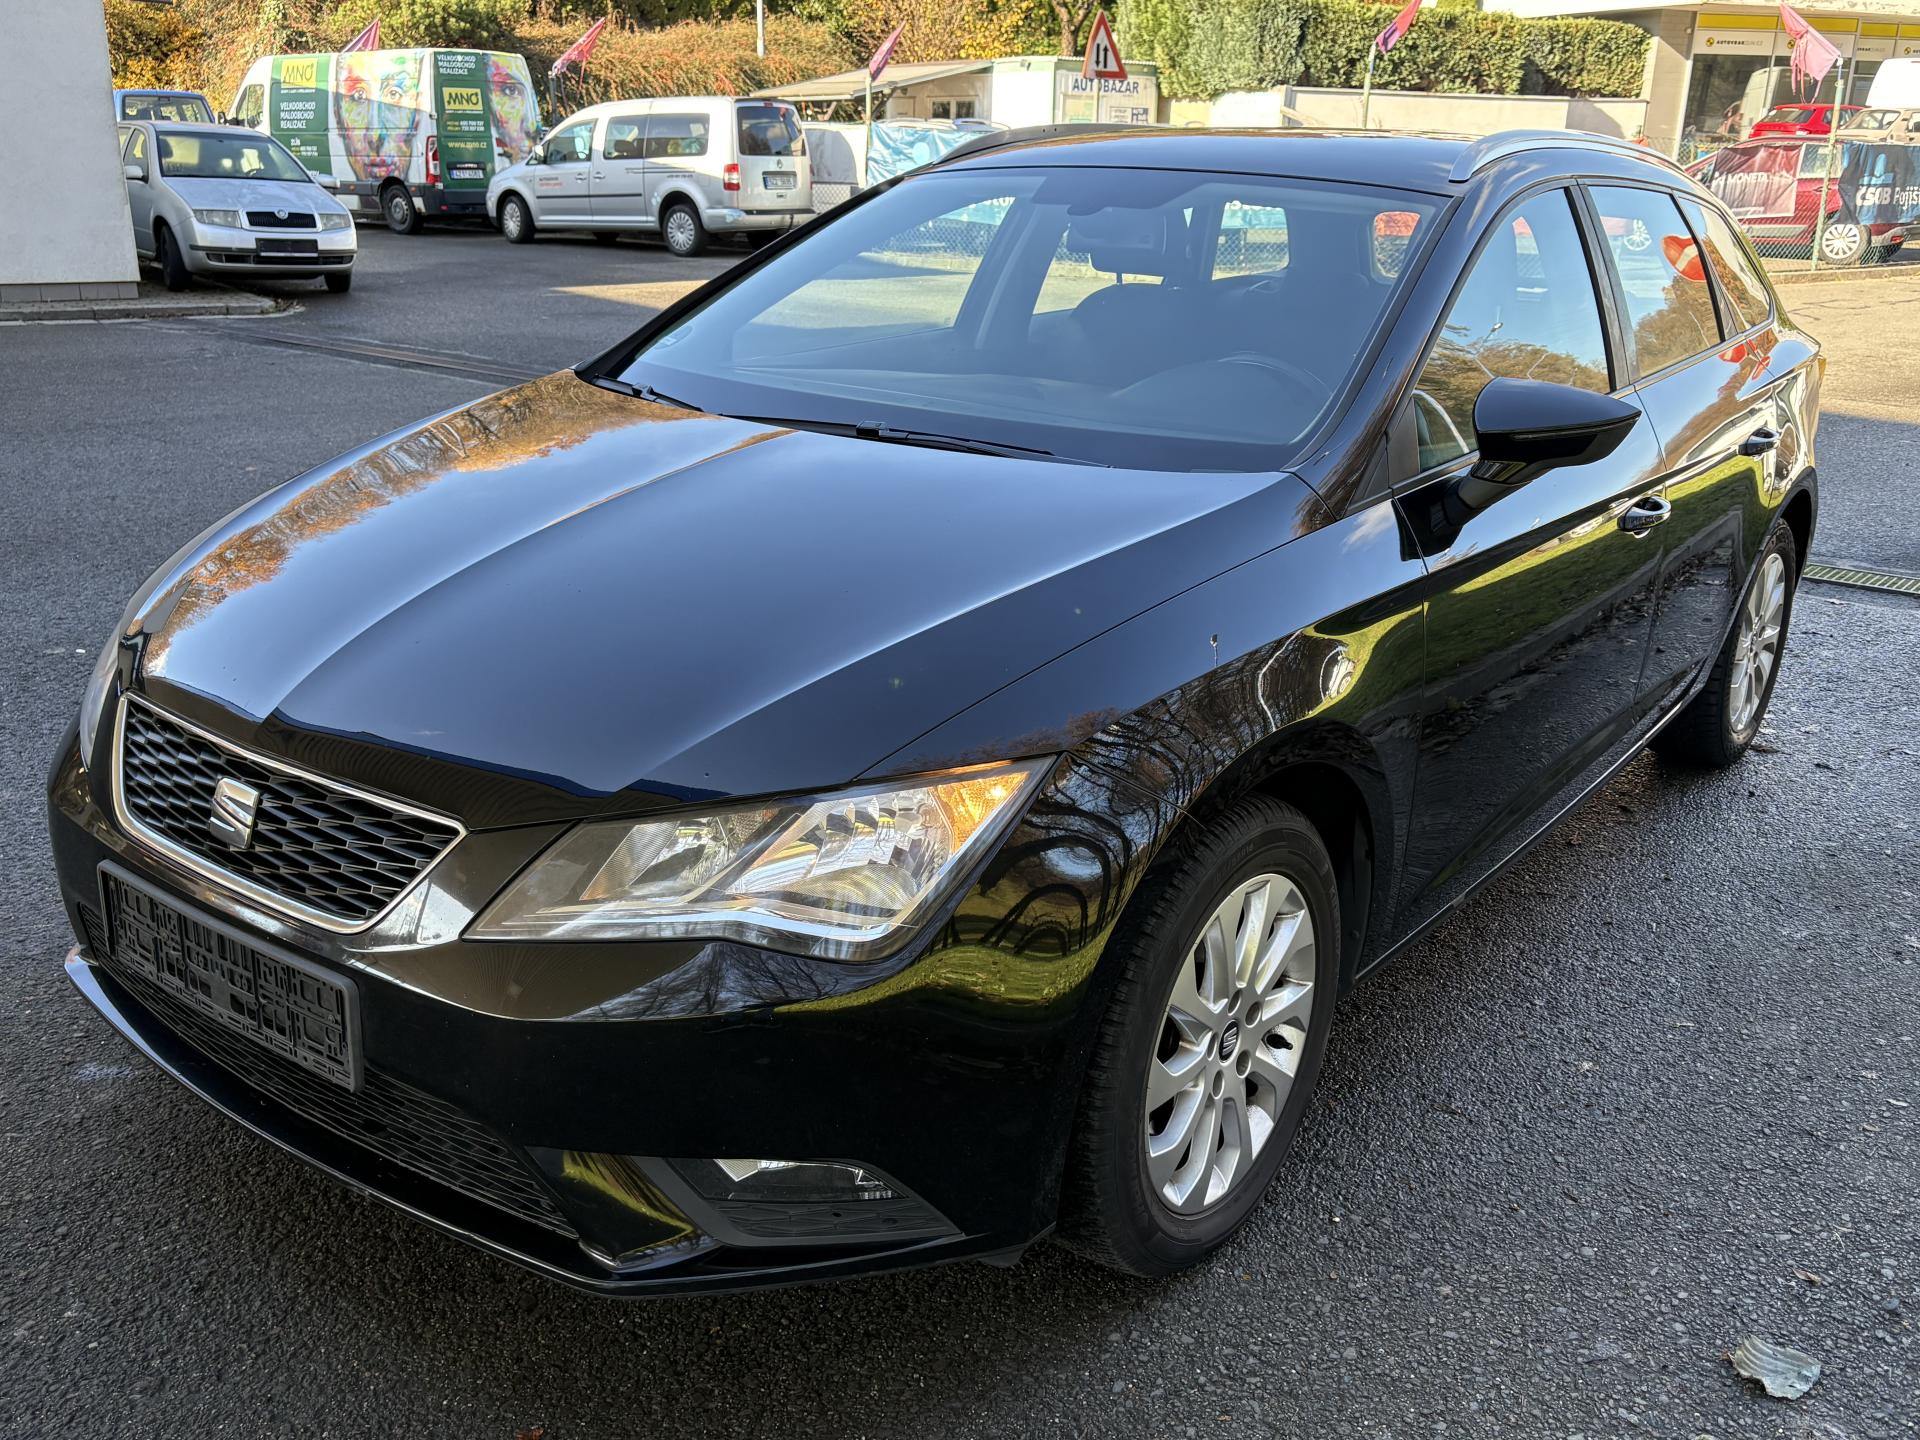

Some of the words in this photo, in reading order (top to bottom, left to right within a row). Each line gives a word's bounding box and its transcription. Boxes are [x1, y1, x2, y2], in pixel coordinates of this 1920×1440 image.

[283, 63, 315, 83] MNO
[446, 92, 480, 106] MNO
[280, 101, 316, 111] VELKOOBCHOD
[280, 110, 315, 120] MALOOBCHOD
[280, 120, 307, 129] REALIZACE
[1855, 185, 1892, 207] ČSOB
